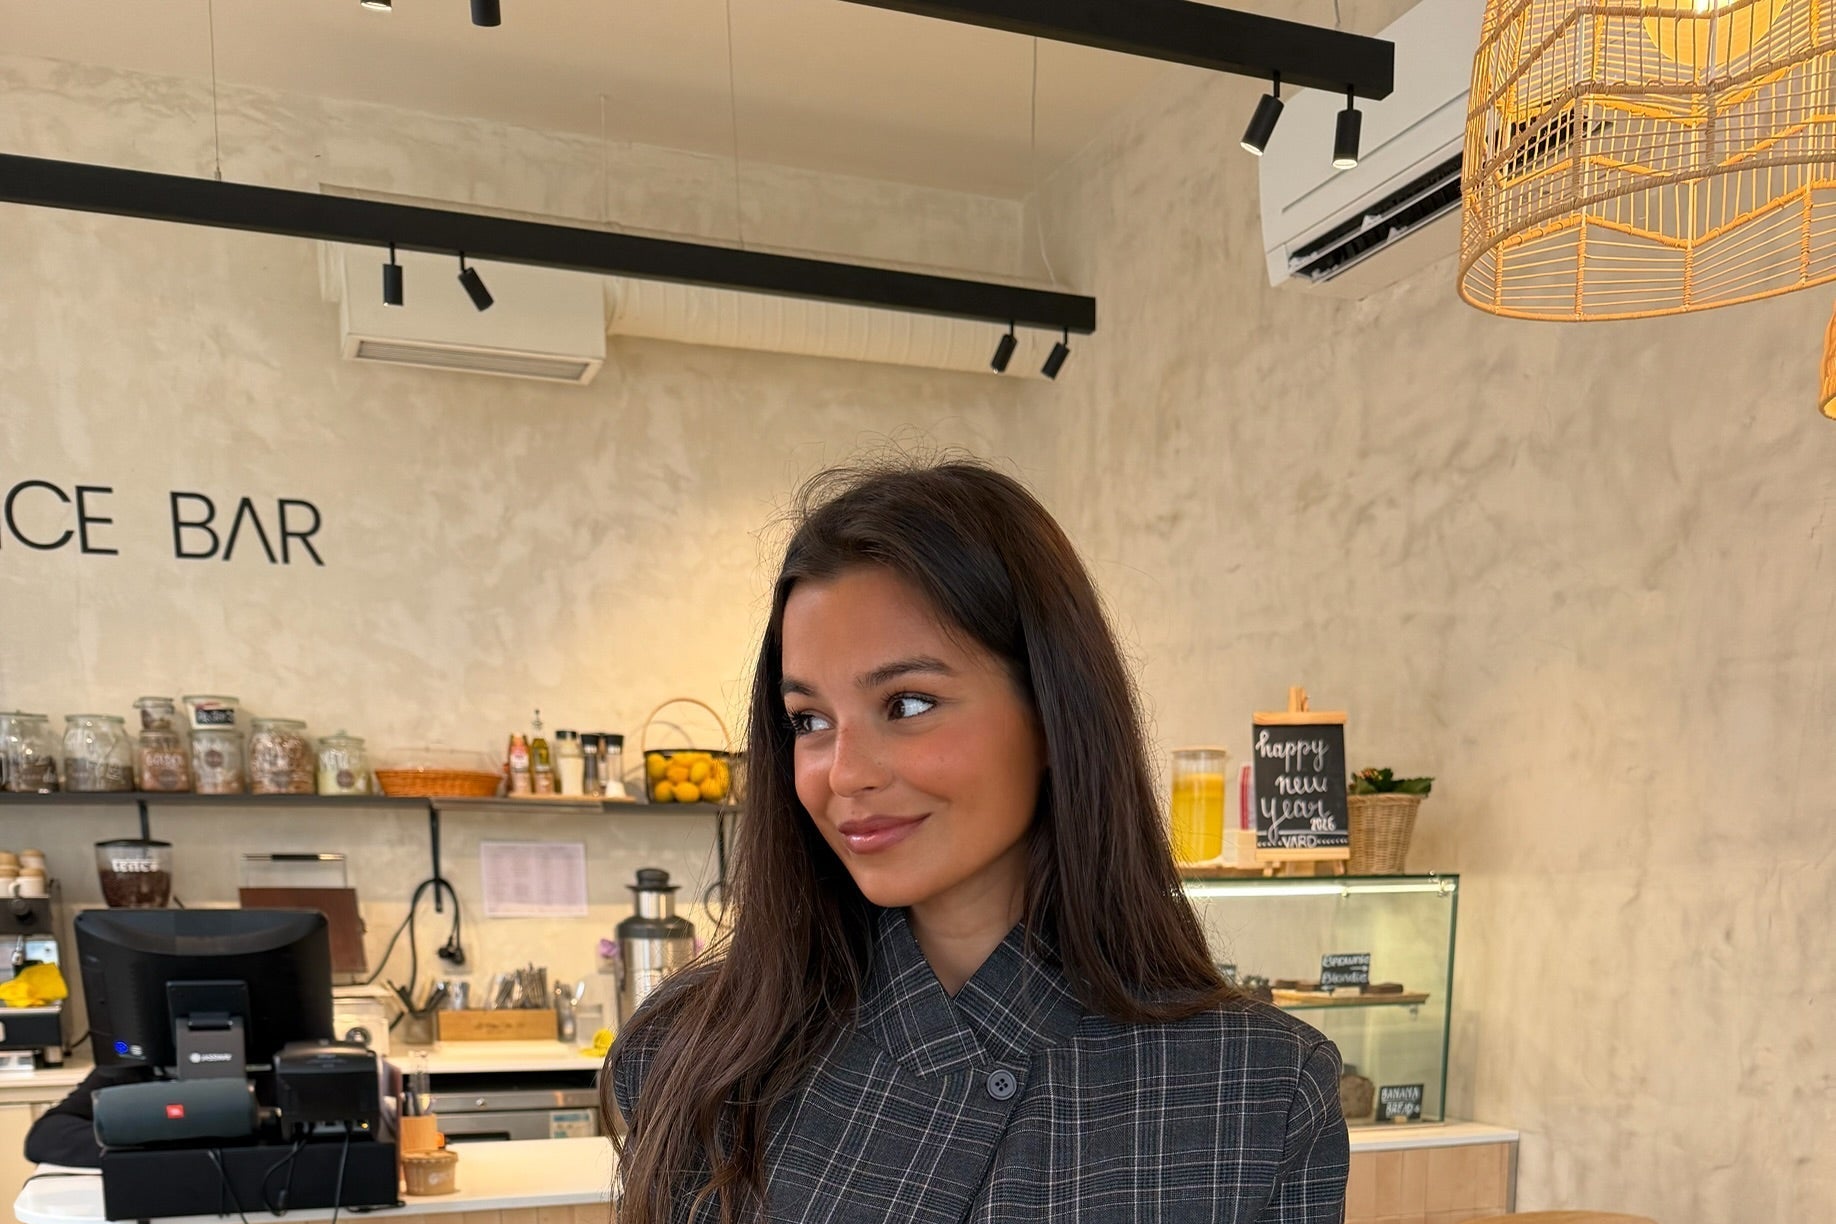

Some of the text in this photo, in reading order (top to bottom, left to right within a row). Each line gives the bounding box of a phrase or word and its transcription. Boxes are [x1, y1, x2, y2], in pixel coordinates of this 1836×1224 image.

[0, 480, 325, 566] CE BAR
[1255, 729, 1330, 772] happy
[1274, 774, 1328, 795] new
[1309, 815, 1337, 832] 2026
